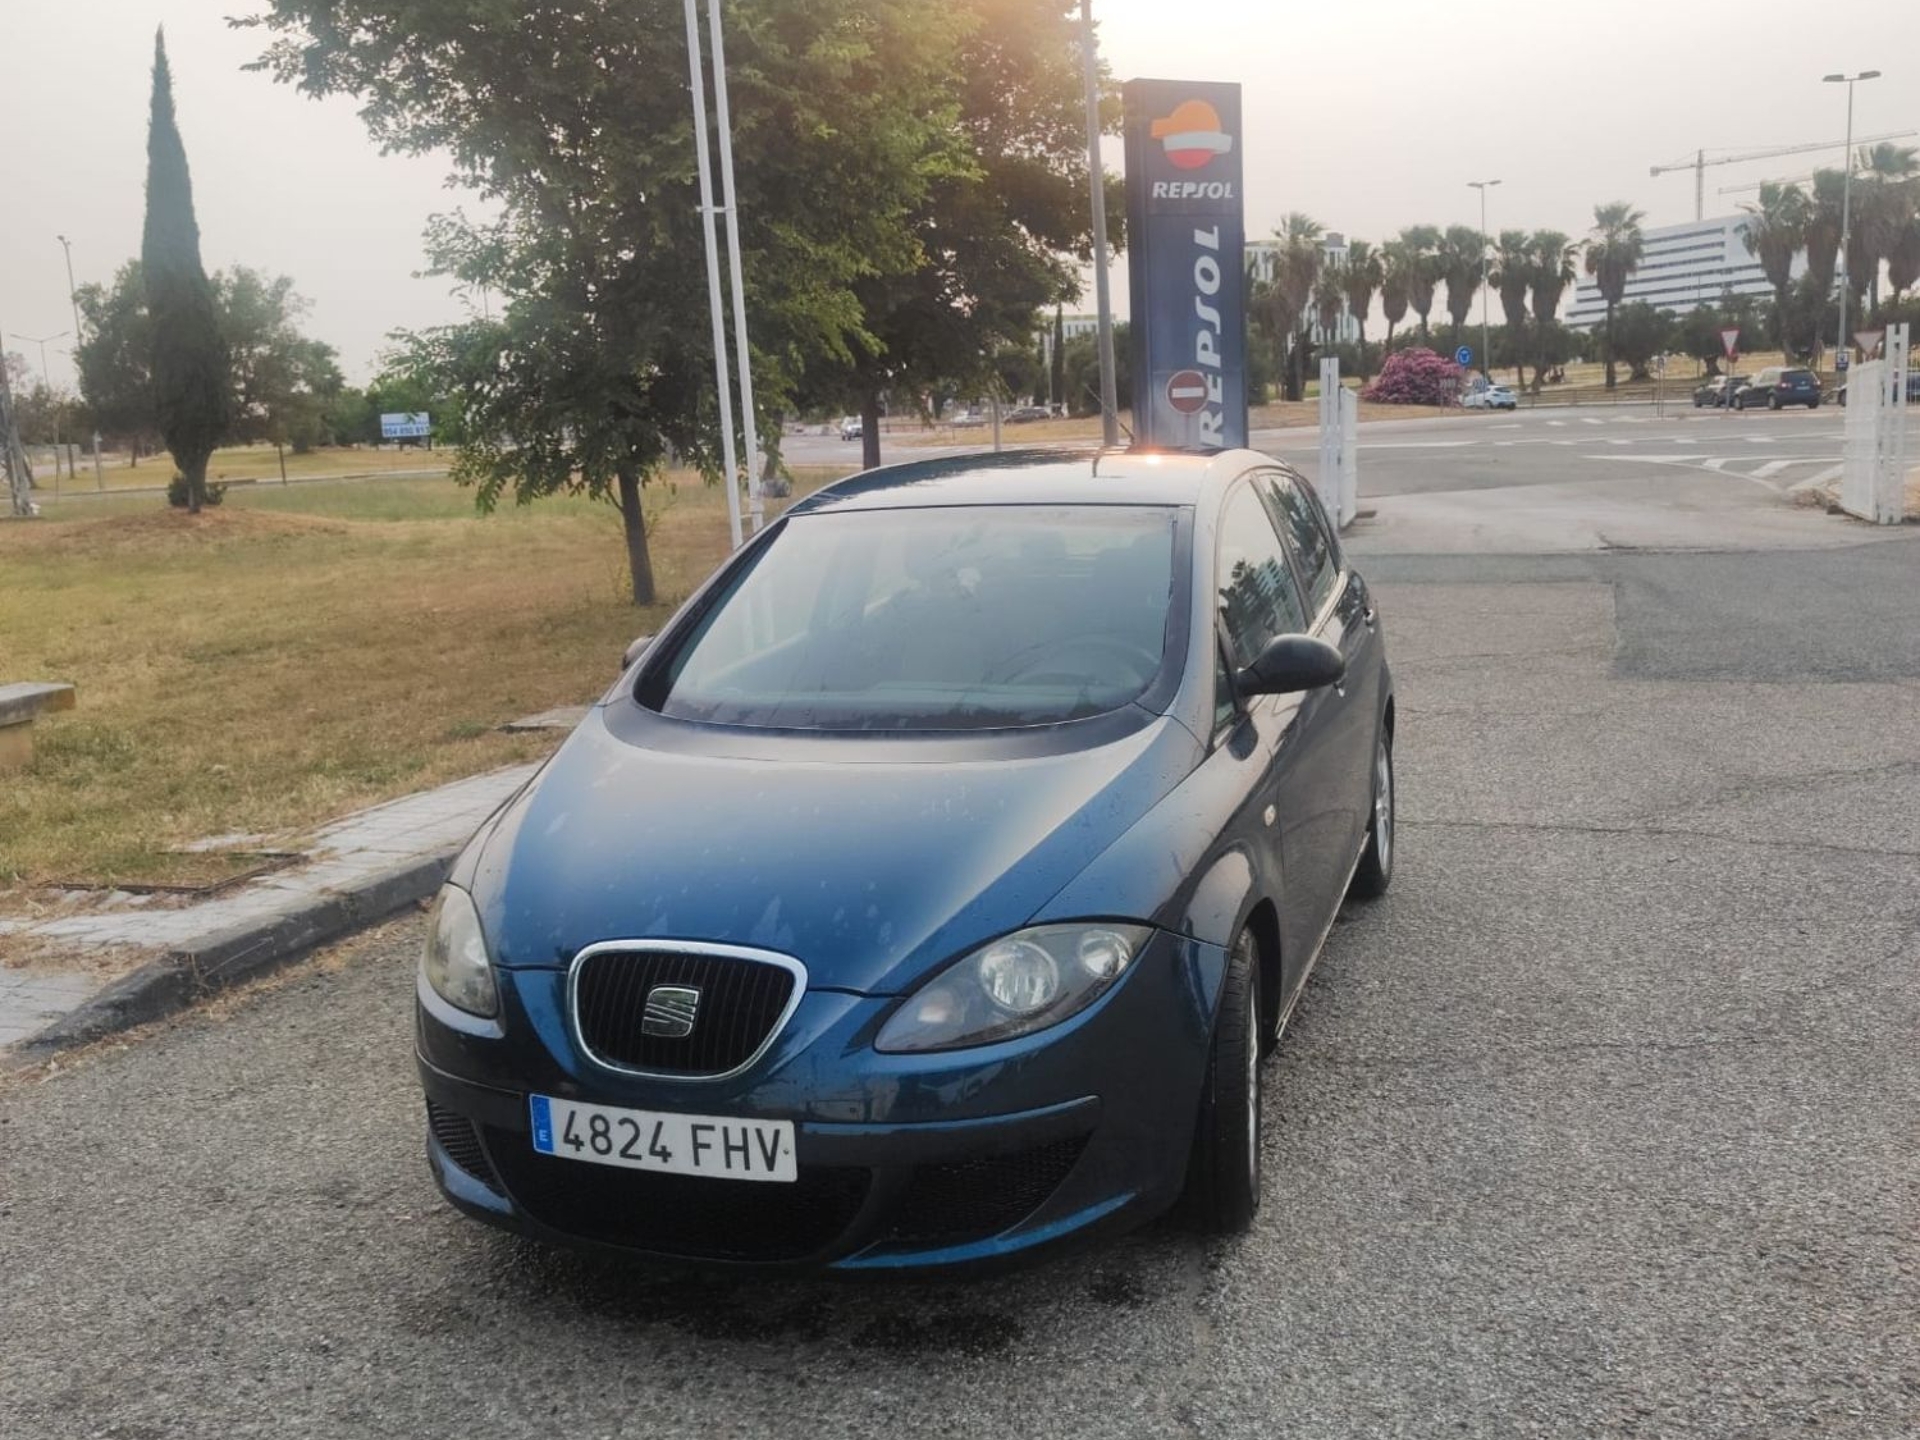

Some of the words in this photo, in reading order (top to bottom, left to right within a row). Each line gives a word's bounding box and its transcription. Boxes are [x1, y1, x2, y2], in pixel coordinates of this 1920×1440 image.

[1152, 181, 1233, 199] REPSOL
[1194, 225, 1223, 446] REPSOL
[539, 1131, 548, 1142] E
[563, 1110, 672, 1163] 4824
[691, 1123, 780, 1172] FHV
